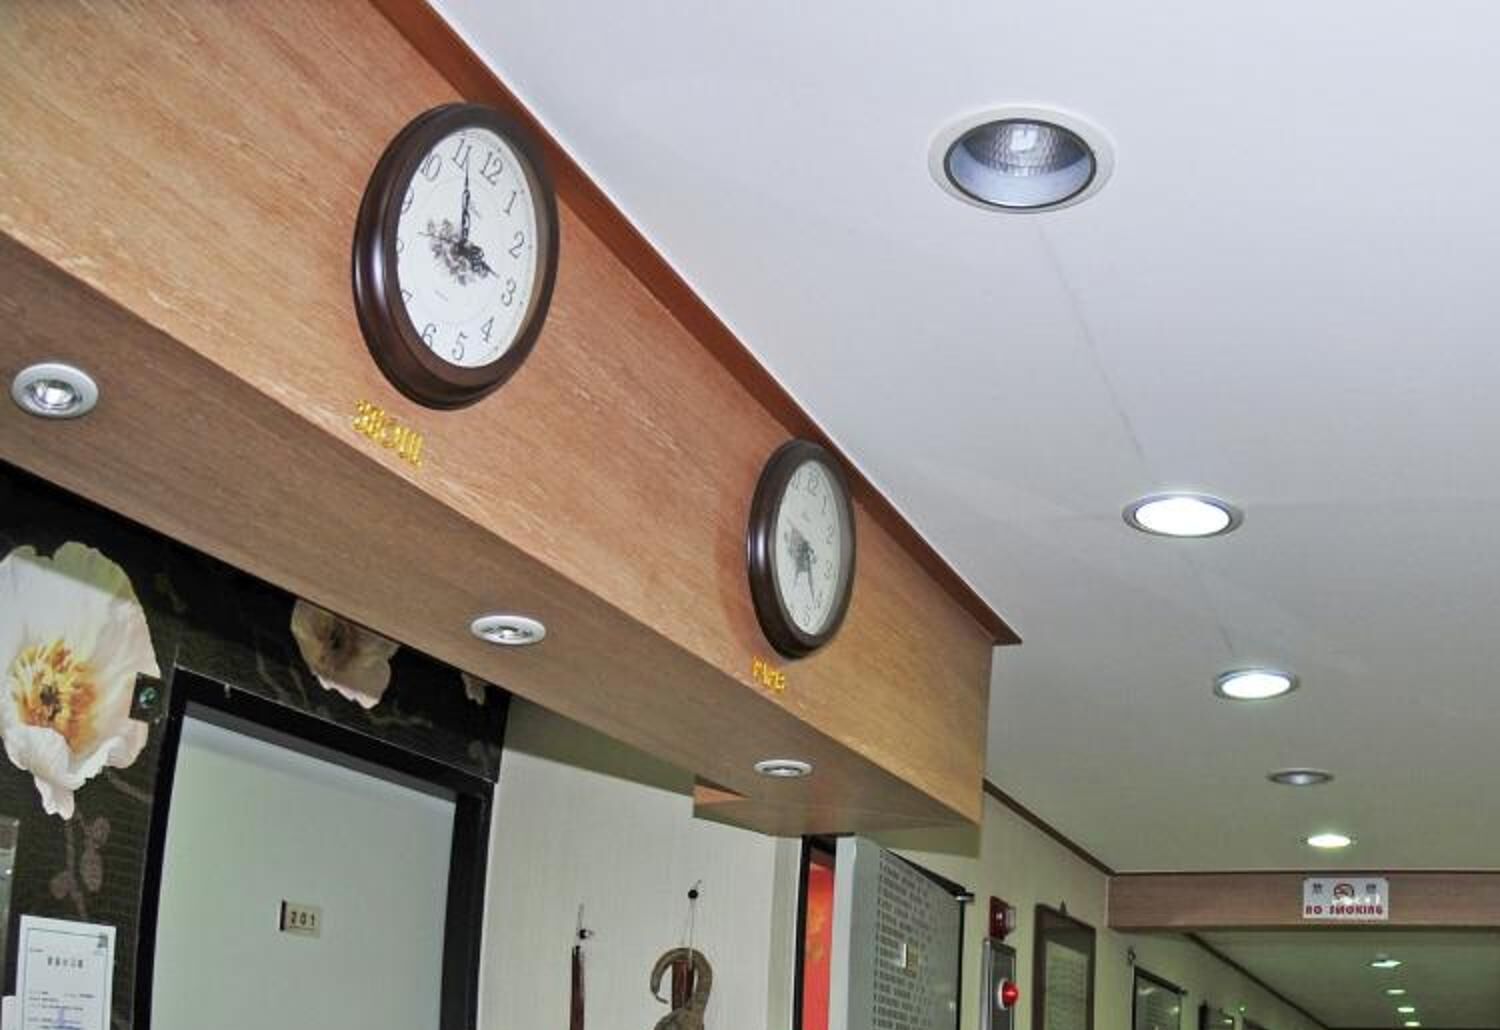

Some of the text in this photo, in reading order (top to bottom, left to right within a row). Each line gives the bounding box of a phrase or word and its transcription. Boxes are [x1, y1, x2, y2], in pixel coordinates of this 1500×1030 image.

[480, 151, 504, 185] 12
[503, 190, 517, 216] 1
[509, 231, 525, 259] 2
[501, 278, 517, 306] 3
[480, 316, 495, 342] 4
[451, 331, 468, 361] 5
[1306, 904, 1384, 915] NO SMOKING
